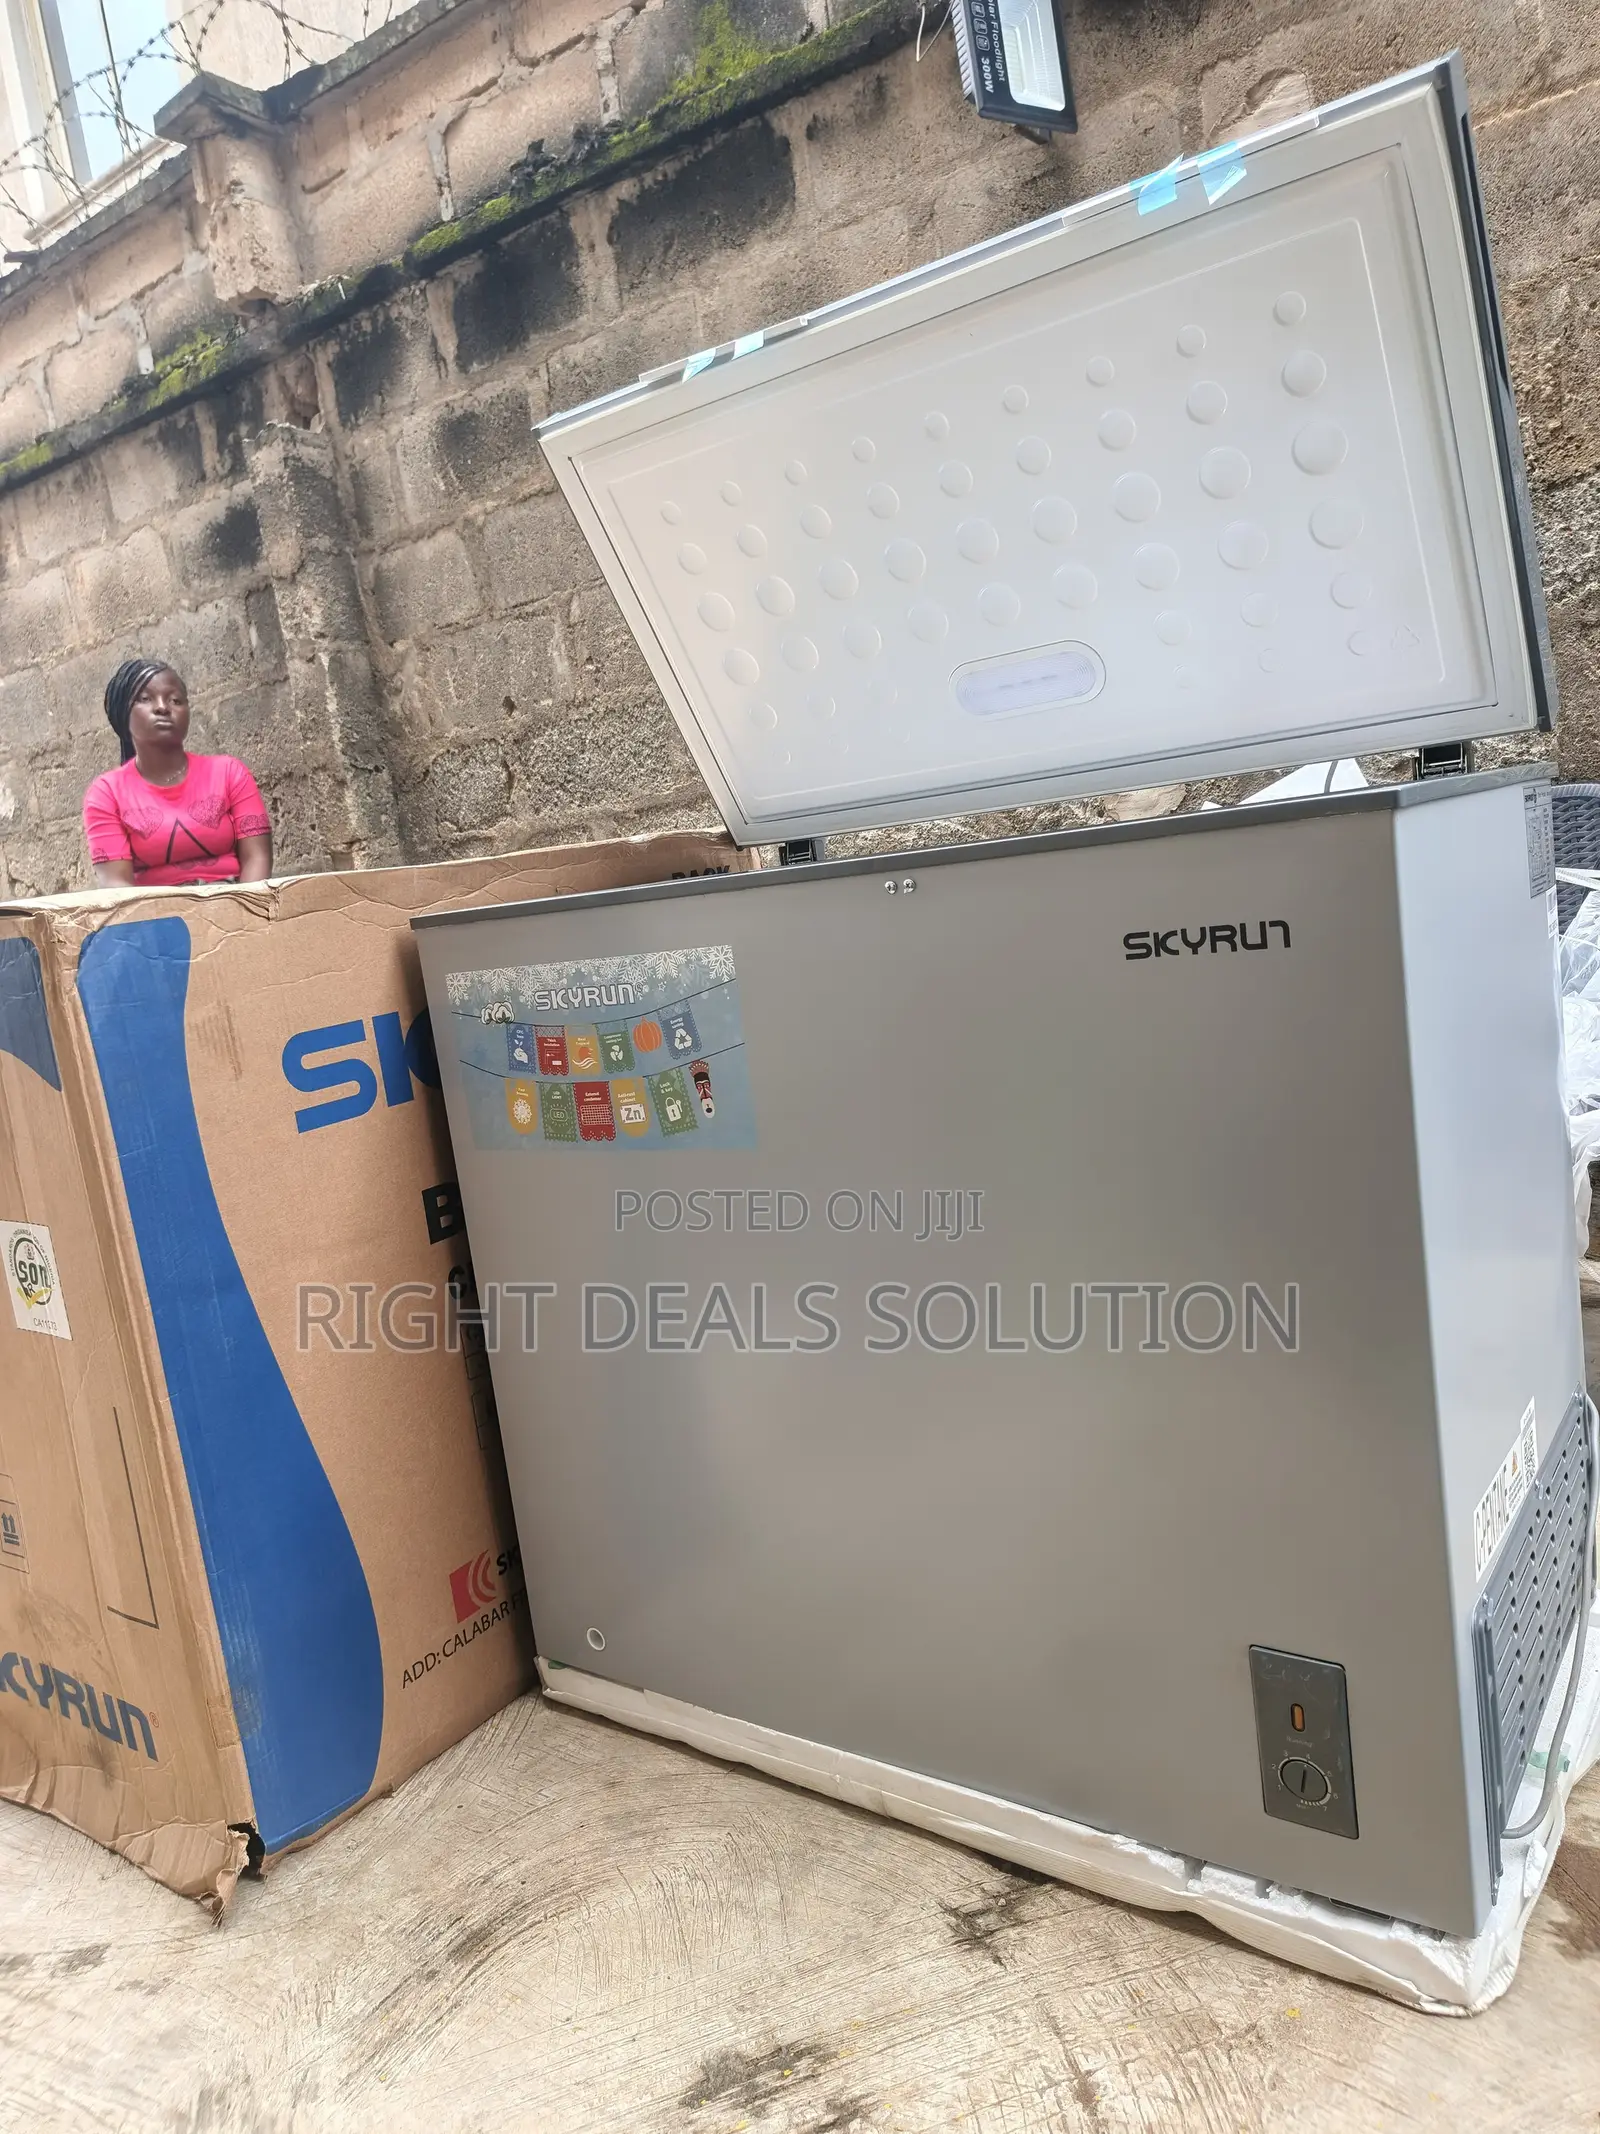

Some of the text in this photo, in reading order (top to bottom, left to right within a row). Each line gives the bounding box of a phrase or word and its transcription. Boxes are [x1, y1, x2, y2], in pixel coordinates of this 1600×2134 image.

[991, 21, 1005, 82] Floodlight
[981, 57, 995, 93] 300W
[1123, 920, 1291, 960] SKYRUN
[534, 982, 635, 1010] SKYRUN
[625, 1107, 642, 1121] Zn
[402, 1651, 442, 1690] ADD:
[442, 1599, 511, 1658] CALABAR
